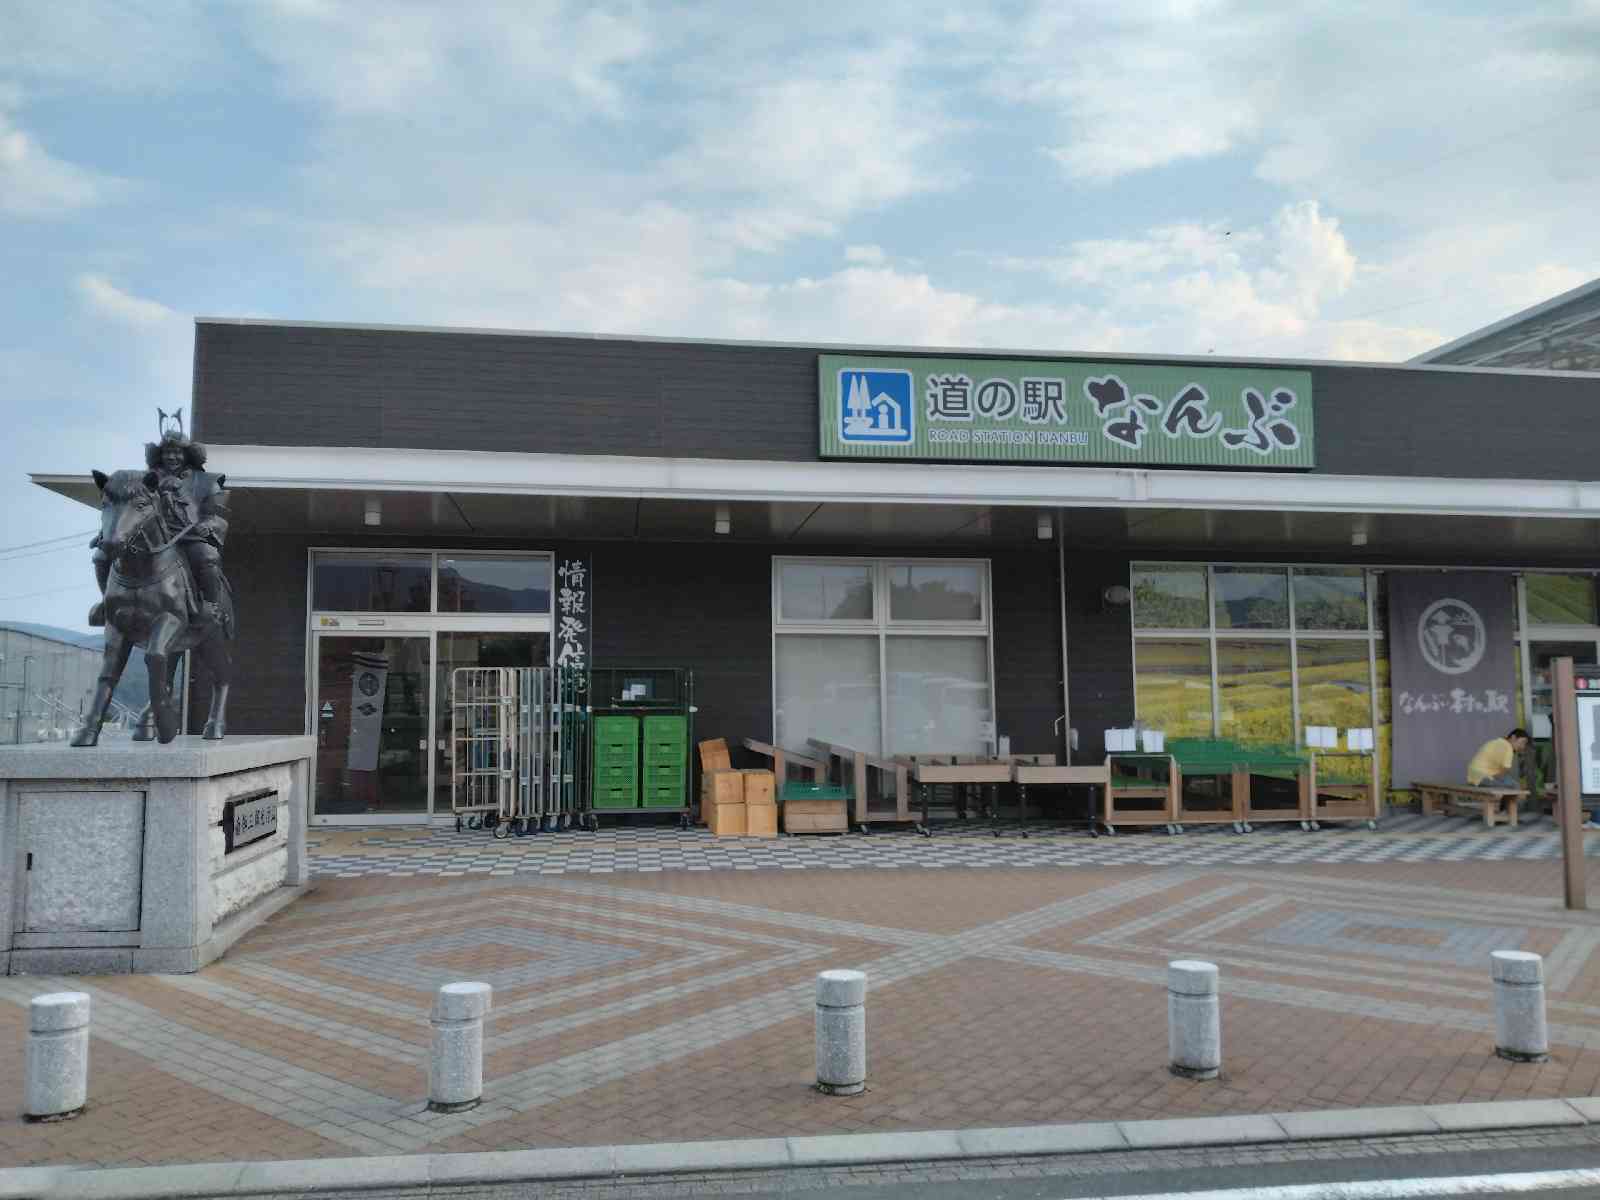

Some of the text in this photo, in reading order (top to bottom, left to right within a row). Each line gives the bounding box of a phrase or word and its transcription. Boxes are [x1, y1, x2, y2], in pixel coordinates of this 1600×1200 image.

[927, 376, 1299, 454] 道の駅 なんぶ
[928, 429, 1088, 445] ROAD STATION NANBU
